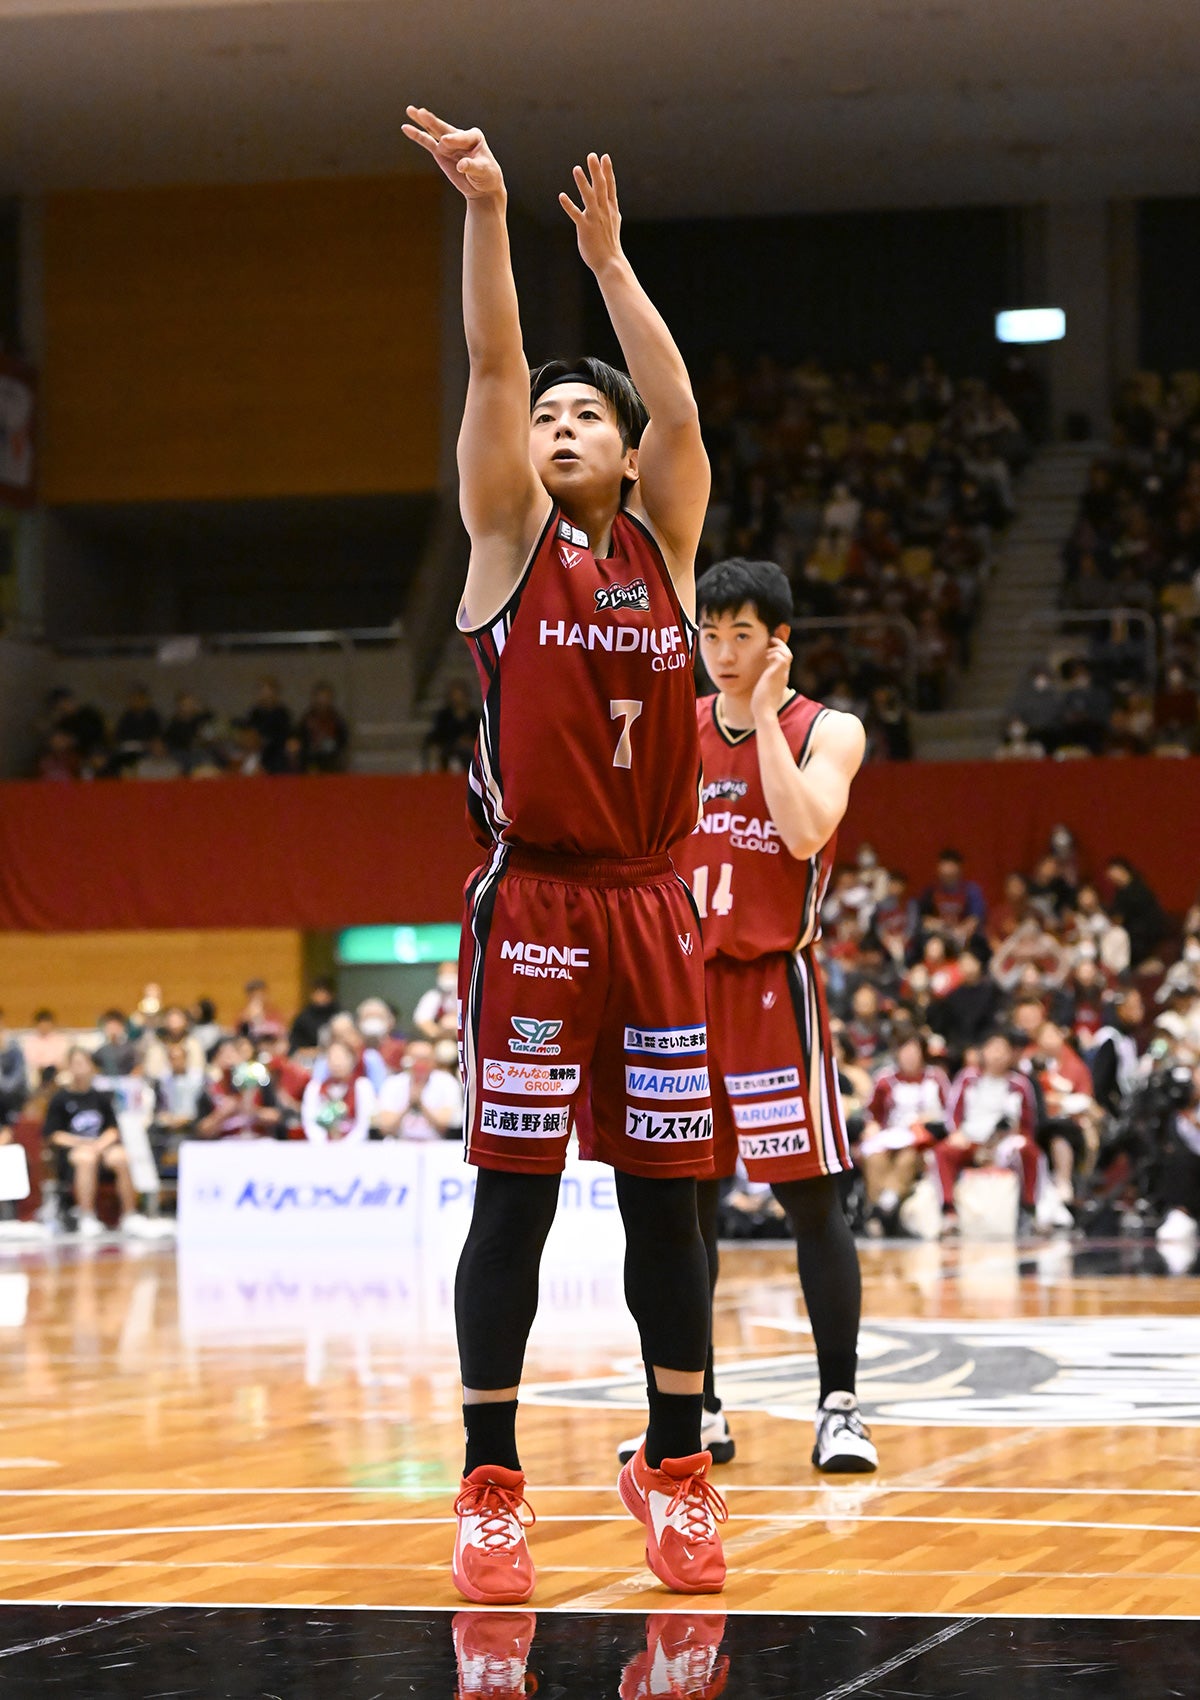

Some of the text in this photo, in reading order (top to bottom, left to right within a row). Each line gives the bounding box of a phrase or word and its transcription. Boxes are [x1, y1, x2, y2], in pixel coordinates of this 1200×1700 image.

[609, 699, 643, 770] 7
[729, 834, 781, 856] CLOUD
[692, 862, 734, 919] 14
[512, 963, 574, 981] RENTAL
[507, 1066, 577, 1081] みんなの整骨院
